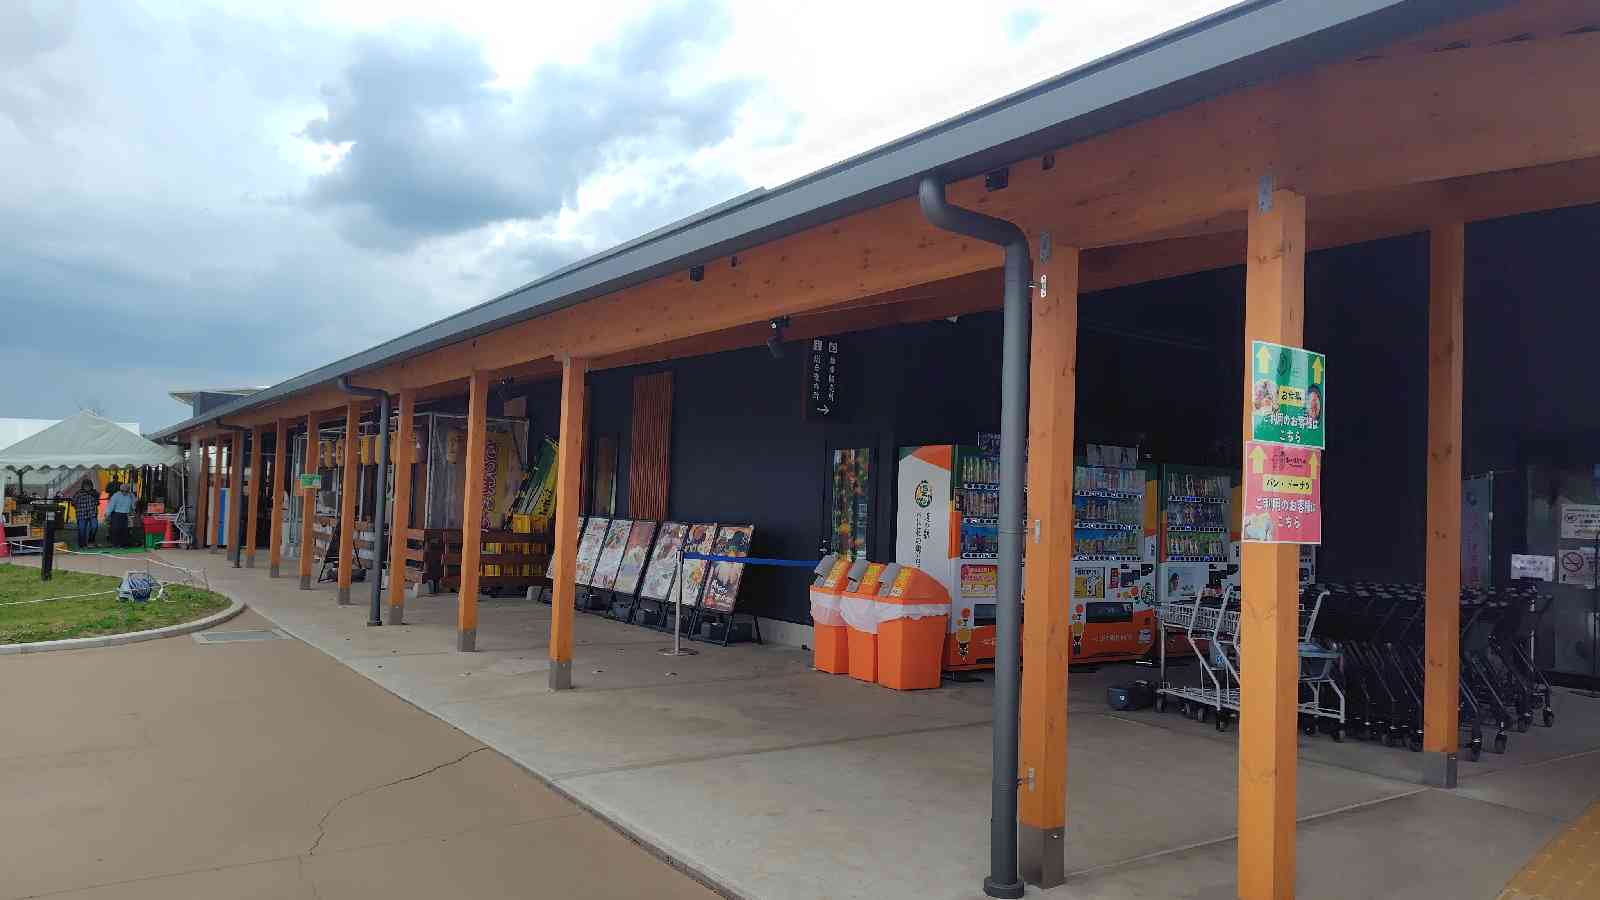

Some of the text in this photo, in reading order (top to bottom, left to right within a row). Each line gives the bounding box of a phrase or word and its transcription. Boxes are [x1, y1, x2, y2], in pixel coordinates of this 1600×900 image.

[1264, 413, 1319, 429] ご利用のお客様は
[1279, 430, 1301, 442] こちら
[1278, 516, 1301, 529] こちら
